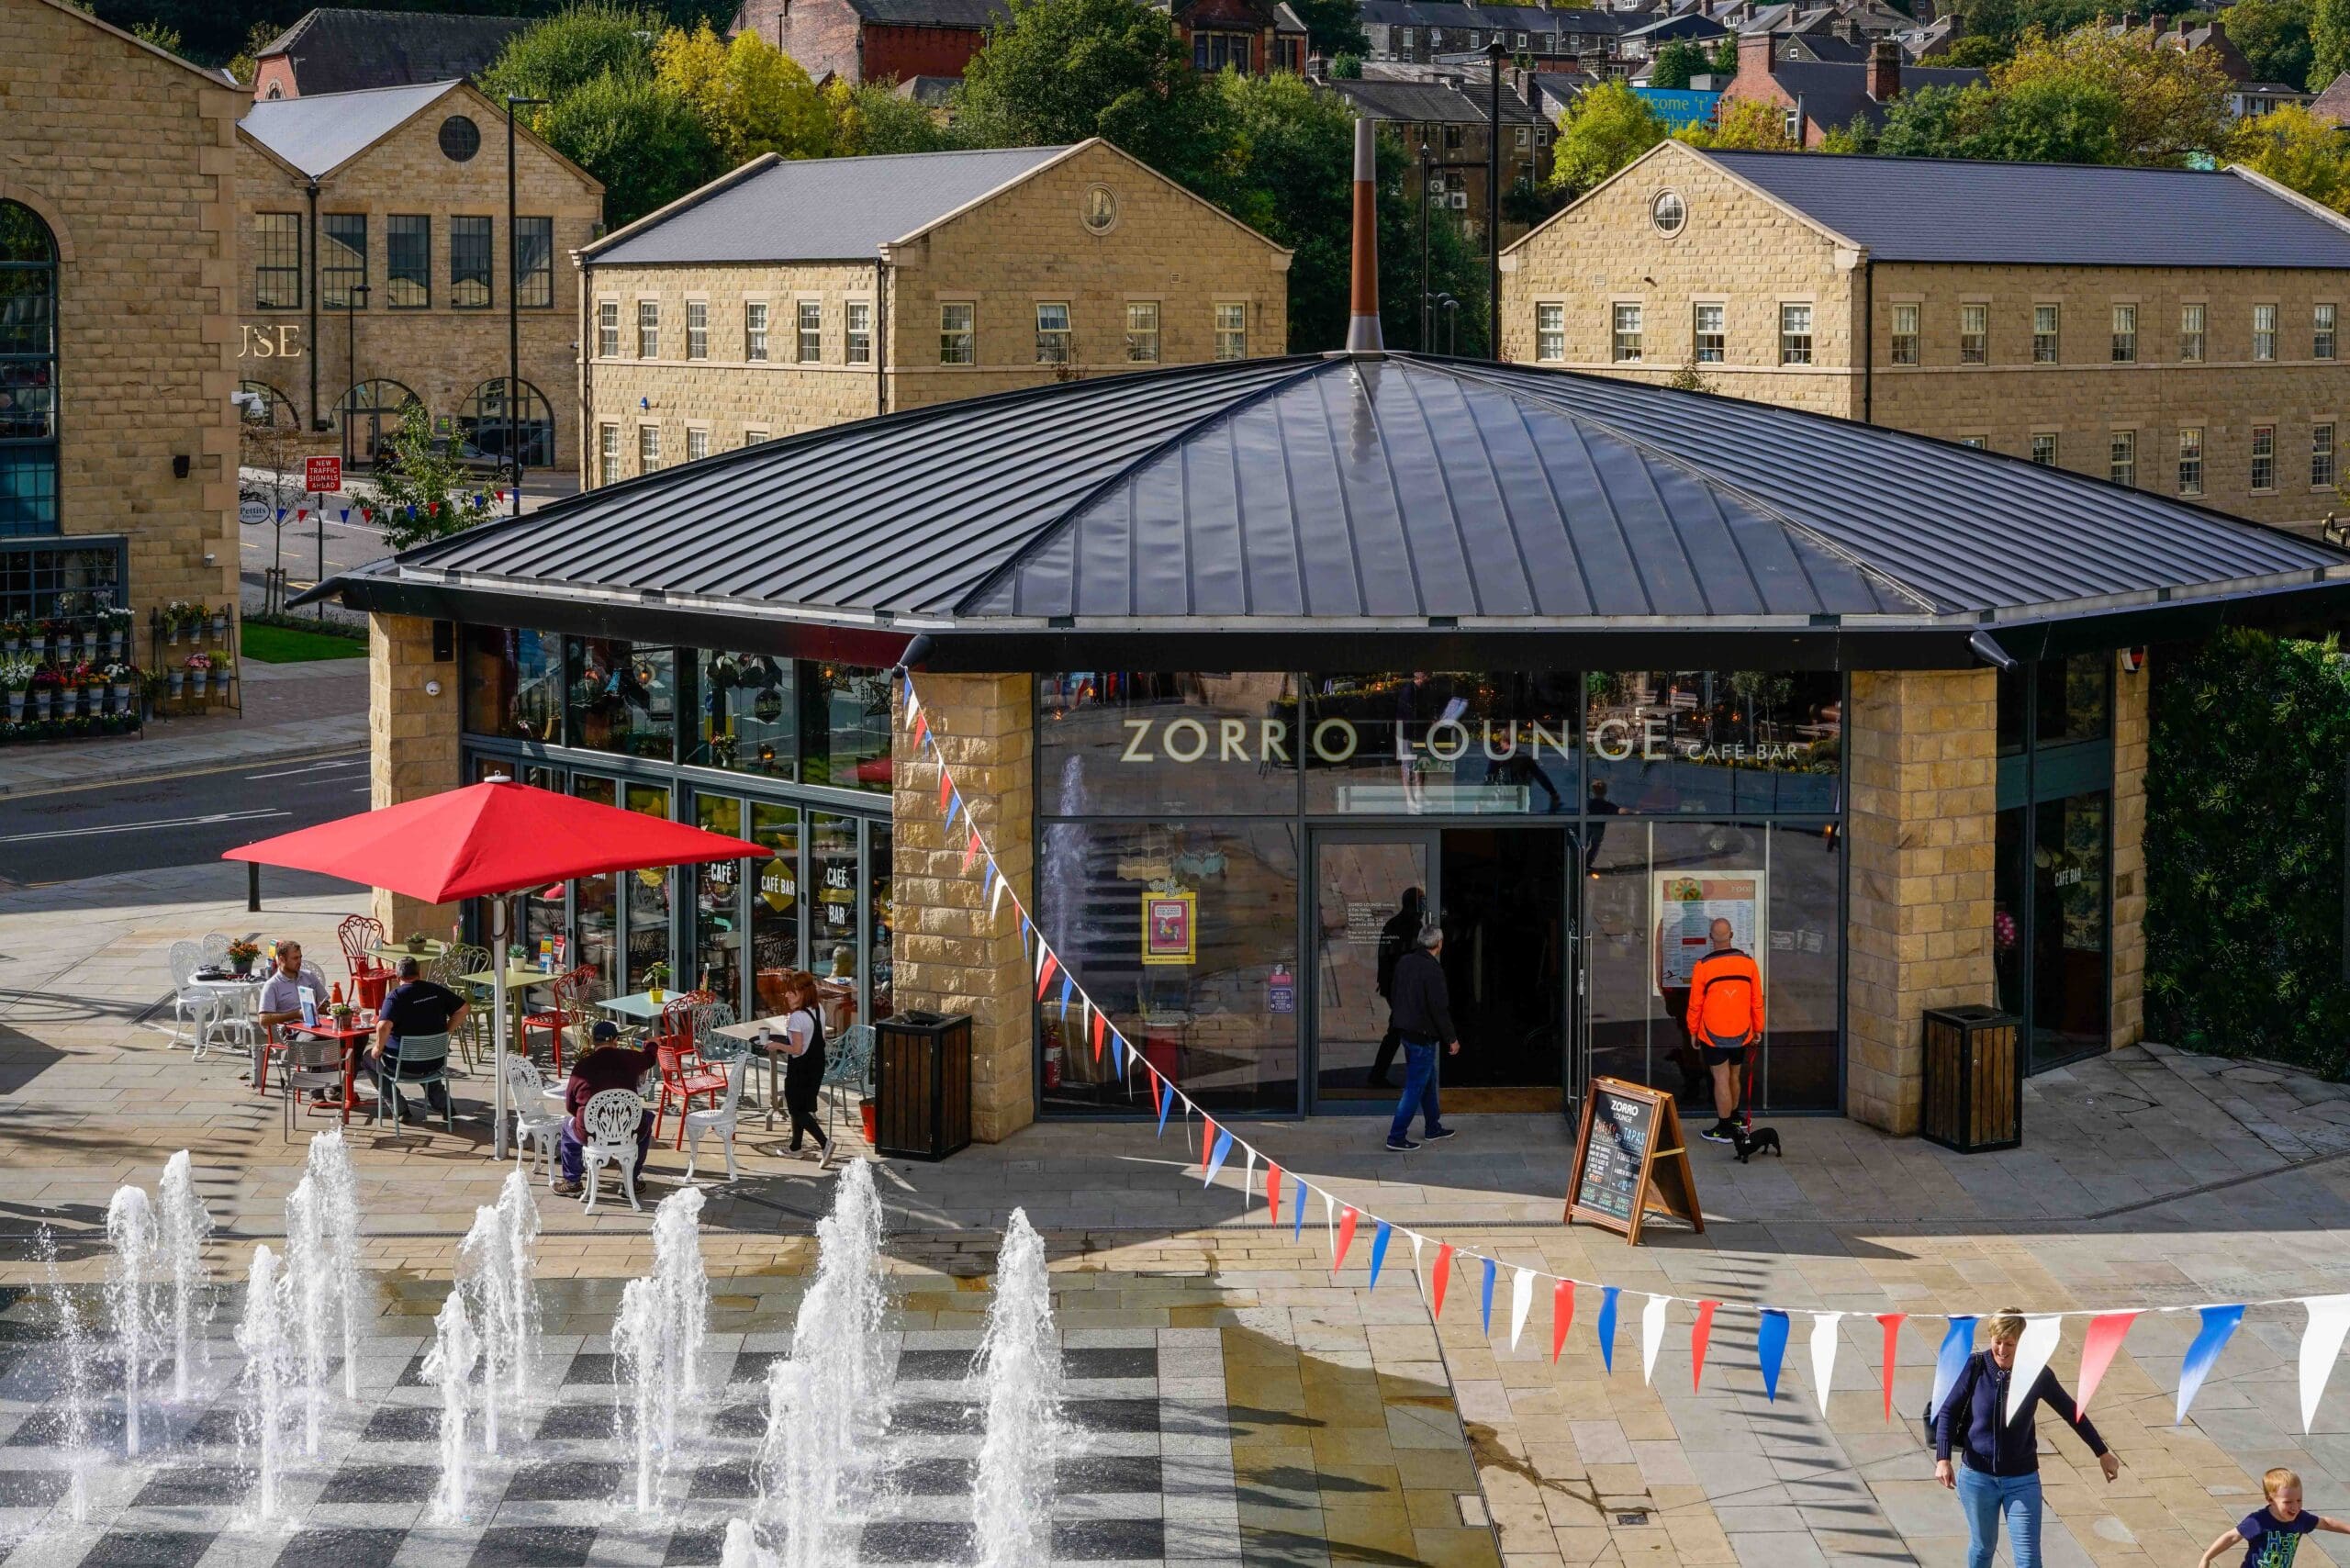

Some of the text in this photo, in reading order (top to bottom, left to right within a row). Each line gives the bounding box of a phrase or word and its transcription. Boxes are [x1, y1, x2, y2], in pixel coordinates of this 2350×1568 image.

[1120, 718, 1798, 763] ZORRO LOUNGE CAFÉ BAR
[711, 862, 732, 884] CAFÉ
[826, 866, 847, 889] CAFÉ
[2054, 866, 2070, 887] CAFÉ
[761, 874, 795, 896] CAFÉ BAR
[828, 904, 845, 925] BAR
[1610, 1100, 1639, 1116] ZORRO
[1613, 1112, 1633, 1124] LOUNGE
[1623, 1127, 1646, 1146] TAPAS
